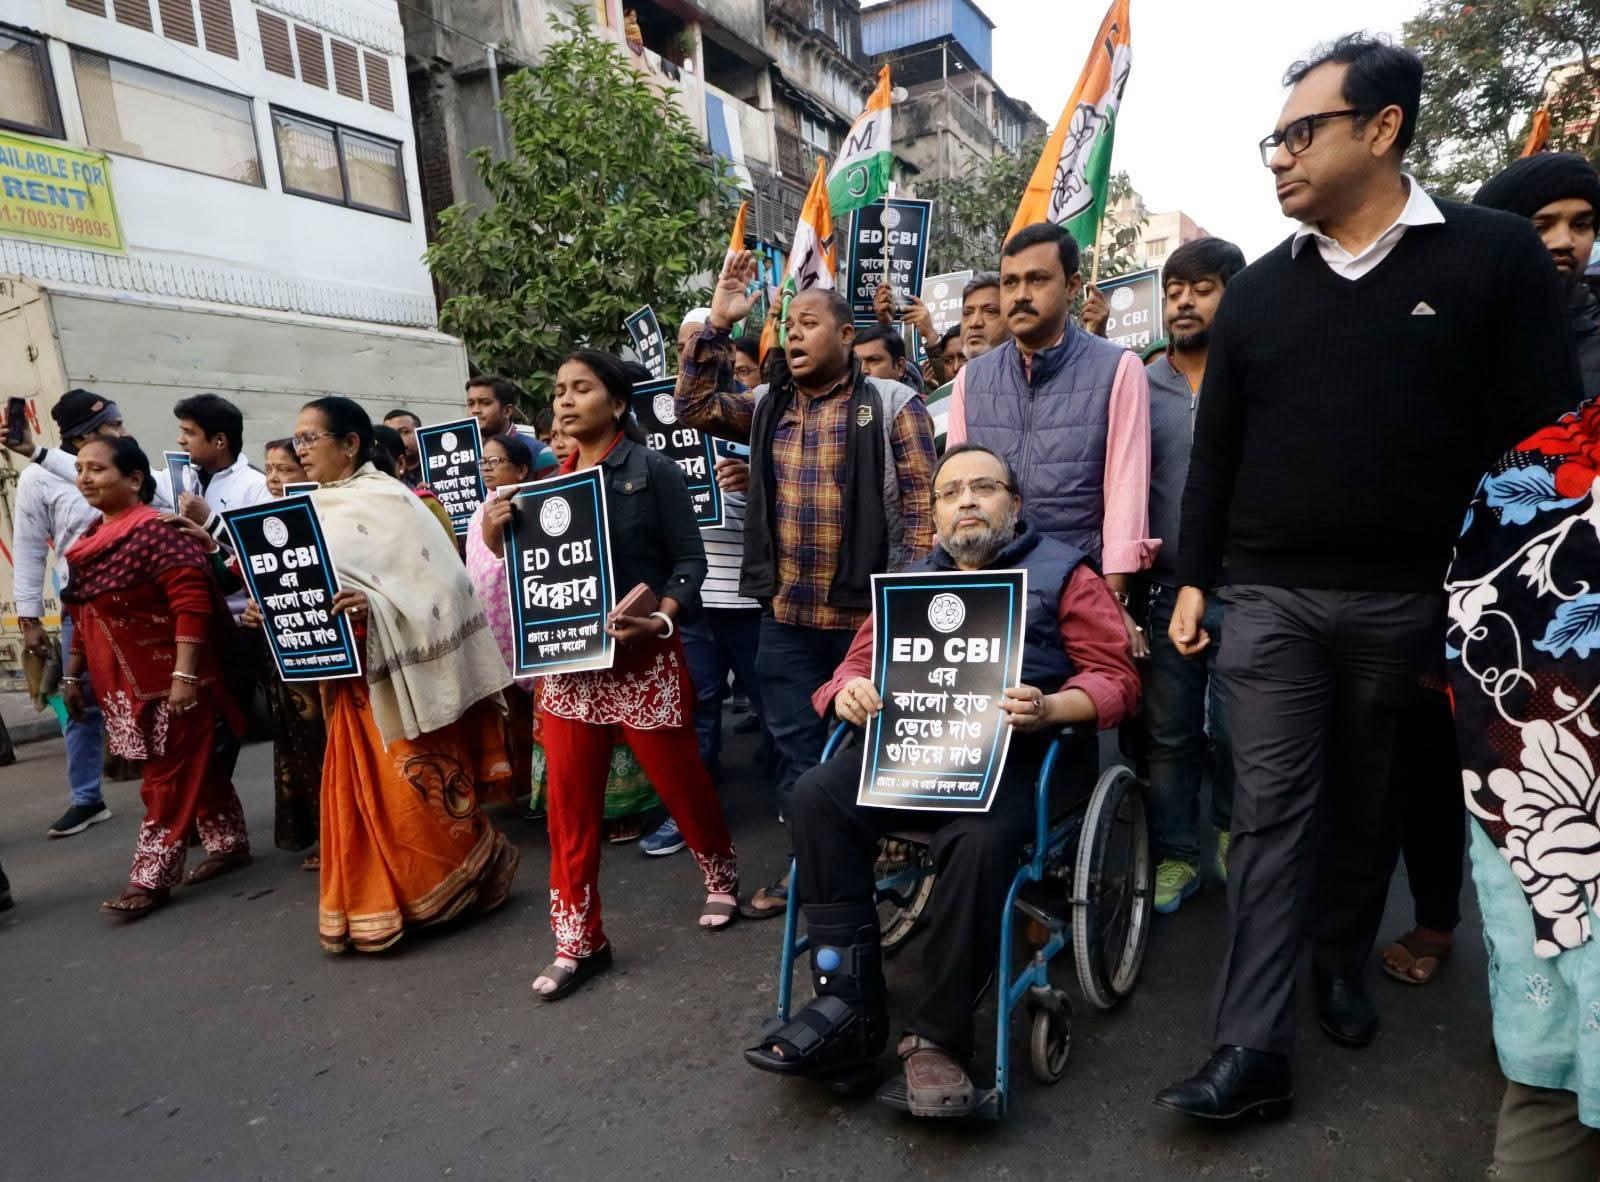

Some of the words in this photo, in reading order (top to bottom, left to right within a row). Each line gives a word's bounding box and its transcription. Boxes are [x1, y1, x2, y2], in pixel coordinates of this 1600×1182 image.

[71, 160, 104, 186] FOR
[2, 175, 87, 210] RENT
[0, 203, 112, 238] 1-7003799895
[859, 229, 883, 244] ED
[888, 231, 918, 245] CBI
[892, 259, 913, 270] হাত
[1106, 318, 1117, 331] D
[1122, 310, 1149, 326] CBI
[671, 428, 701, 448] CBI
[428, 454, 447, 469] ED
[450, 449, 475, 465] CBI
[446, 466, 460, 476] এর
[433, 478, 458, 491] কালো
[459, 475, 476, 488] হাত
[250, 553, 278, 575] ED
[282, 545, 320, 567] CBI
[522, 547, 550, 572] ED
[557, 538, 593, 567] CBI
[279, 572, 299, 587] এর
[263, 590, 299, 611] কালো
[299, 588, 325, 608] হাত
[522, 575, 598, 610] ধিক্কার
[304, 609, 329, 626] দাও
[313, 627, 338, 644] দাও
[892, 637, 934, 662] ED
[943, 637, 1001, 662] CBI
[928, 667, 958, 687] এর
[892, 690, 949, 714] কালো
[952, 691, 991, 716] হাত
[895, 718, 943, 738] ভেঙে
[948, 718, 982, 740] দাও
[886, 737, 945, 767] গুড়িয়ে
[949, 744, 982, 766] দাও
